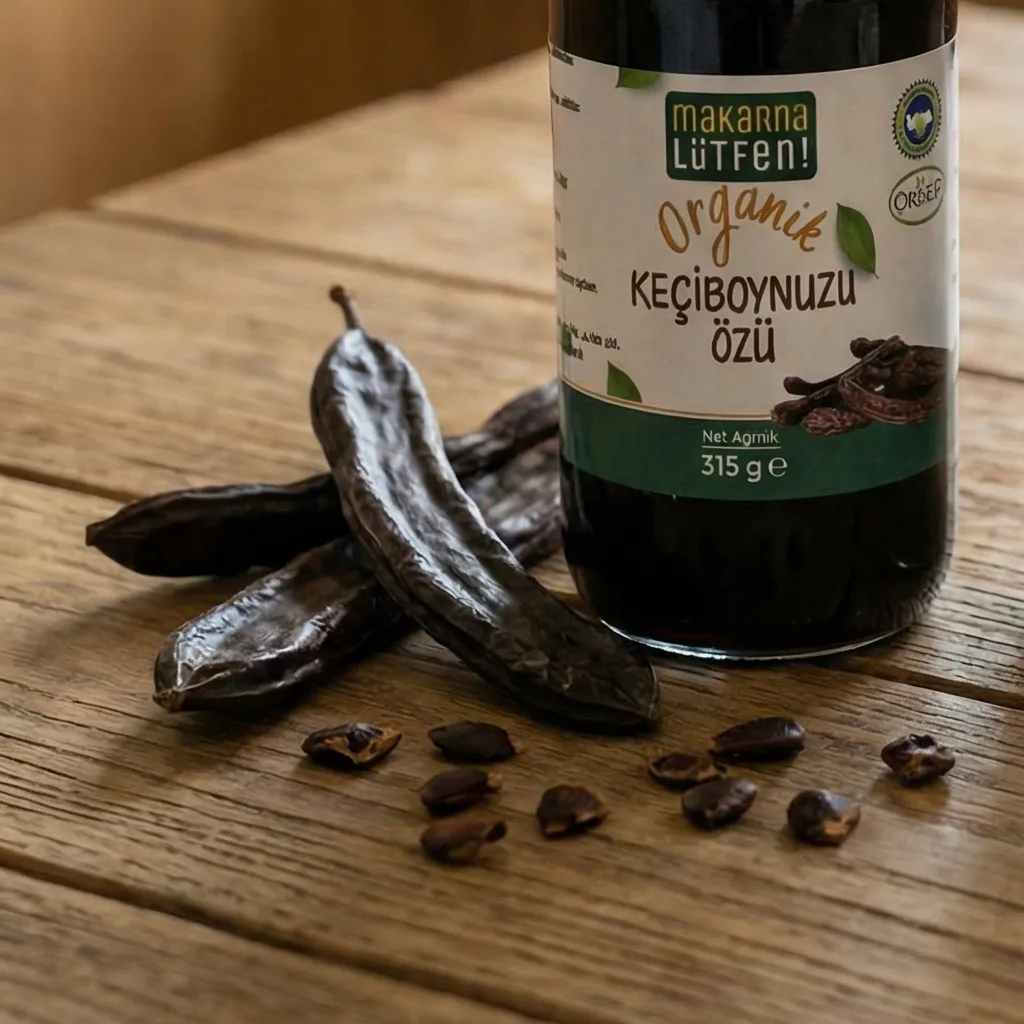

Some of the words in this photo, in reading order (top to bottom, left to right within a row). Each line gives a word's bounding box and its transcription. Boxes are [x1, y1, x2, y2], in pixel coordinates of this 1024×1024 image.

[658, 184, 828, 267] Organik
[710, 317, 776, 364] ÖZÜ
[702, 428, 728, 444] Net
[701, 454, 740, 477] 315
[746, 460, 762, 483] g
